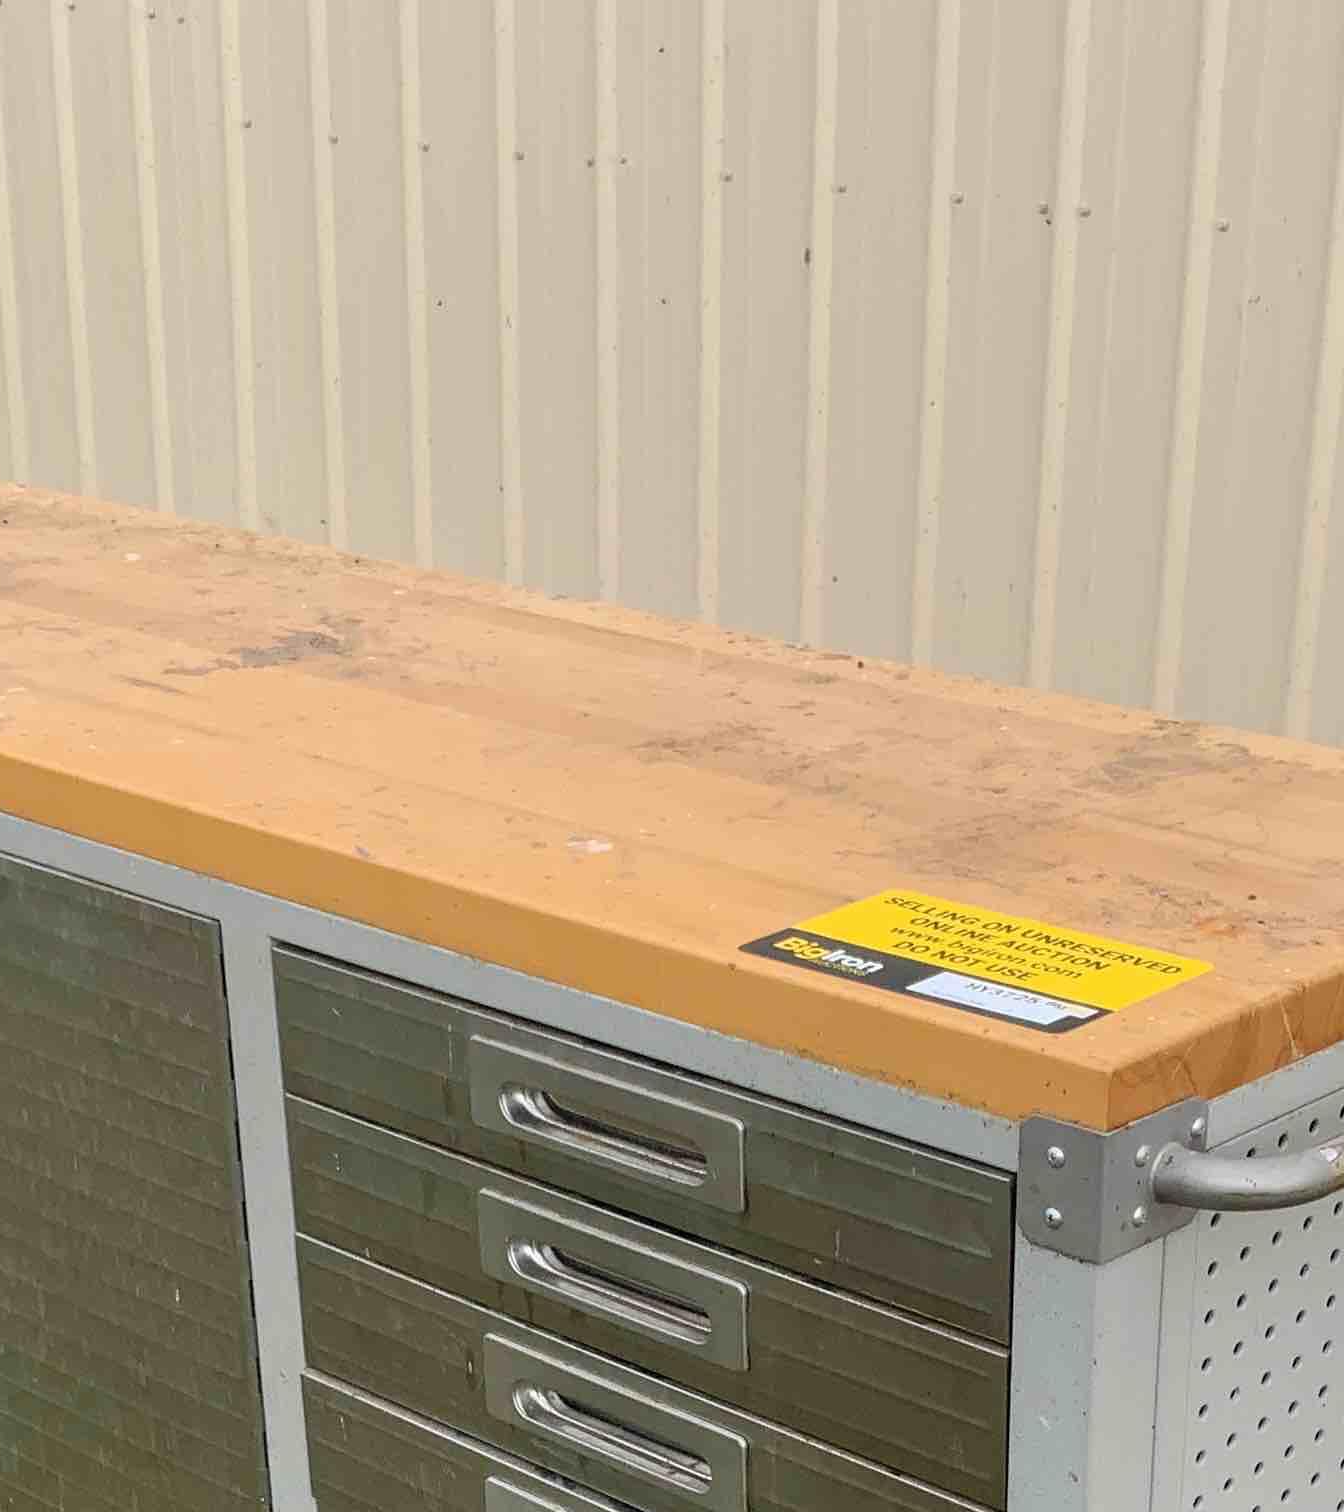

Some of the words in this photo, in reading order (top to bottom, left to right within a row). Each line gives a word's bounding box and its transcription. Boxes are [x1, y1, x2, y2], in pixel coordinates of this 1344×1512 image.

[773, 936, 884, 975] BigIron
[884, 896, 981, 925] SELLING
[982, 922, 1020, 934] ON
[1021, 928, 1183, 974] UNRESERVED
[910, 917, 998, 942] ONLINE
[997, 940, 1111, 970] AUCTION
[892, 940, 931, 954] DO
[930, 950, 988, 967] NOT
[986, 963, 1040, 981] USE
